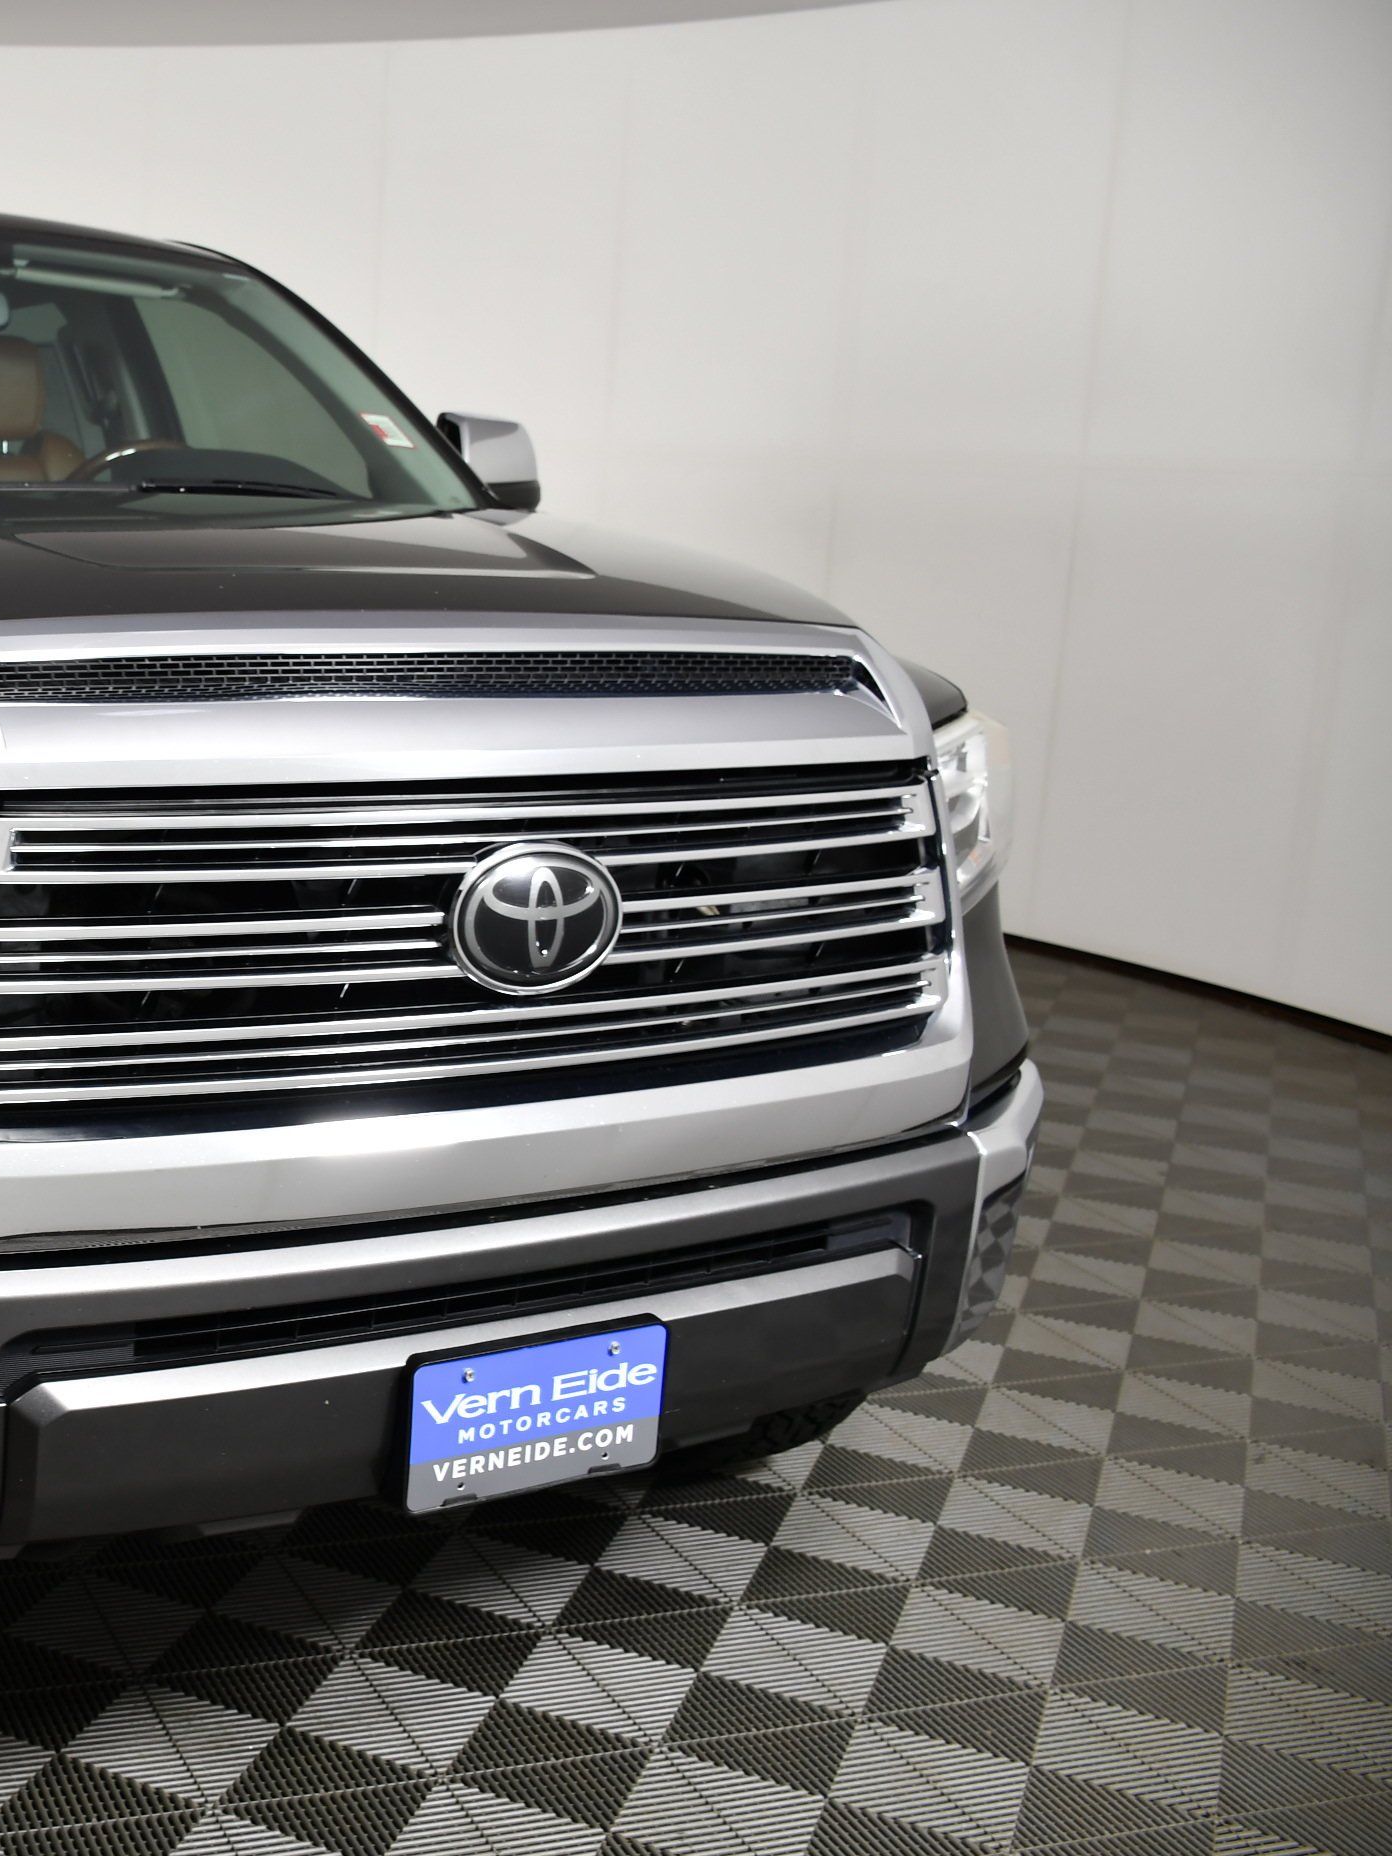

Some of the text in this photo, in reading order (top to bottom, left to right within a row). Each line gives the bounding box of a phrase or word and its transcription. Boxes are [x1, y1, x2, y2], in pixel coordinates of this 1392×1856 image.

[420, 1362, 657, 1425] Vern Eide
[458, 1397, 627, 1444] MOTORCARS
[432, 1424, 634, 1482] VERNEIDE.COM
